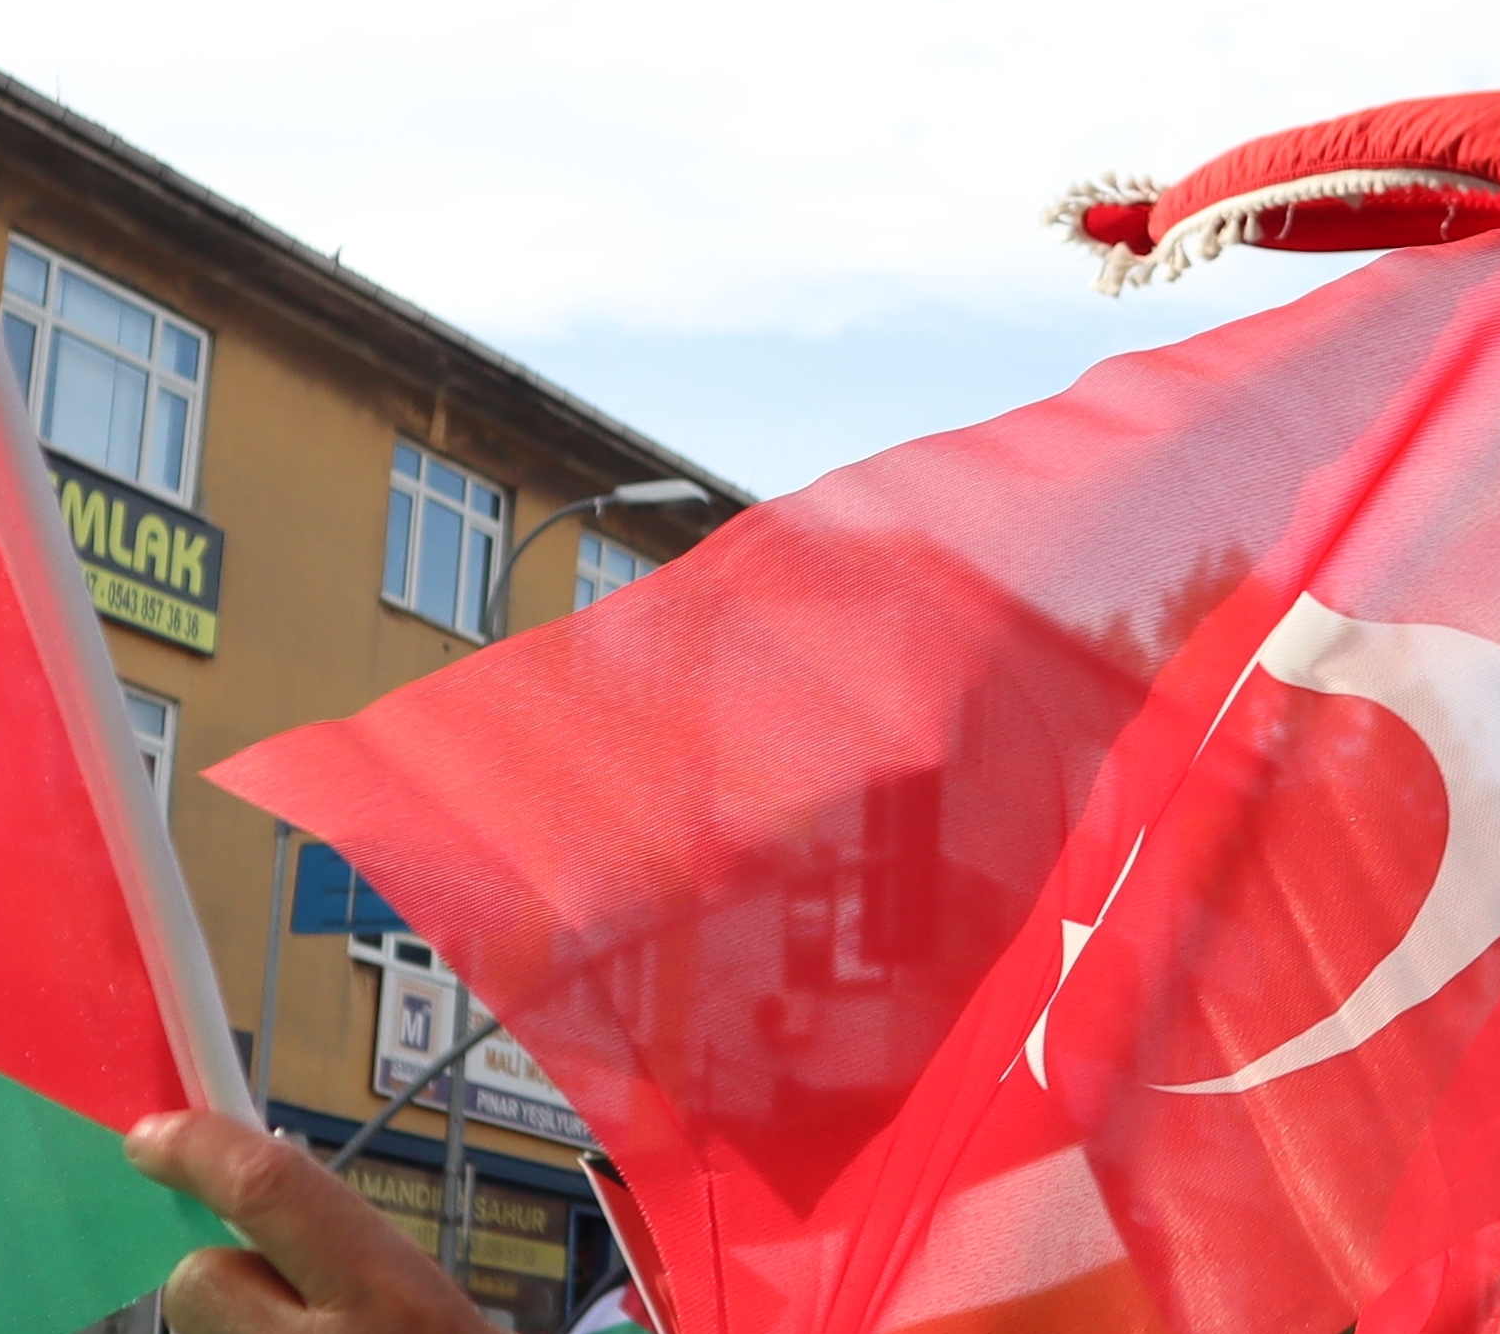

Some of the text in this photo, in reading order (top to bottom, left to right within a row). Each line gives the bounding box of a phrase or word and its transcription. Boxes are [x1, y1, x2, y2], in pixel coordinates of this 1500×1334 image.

[50, 471, 208, 598] MLAK
[107, 579, 138, 616] 0543
[141, 593, 164, 624] 857
